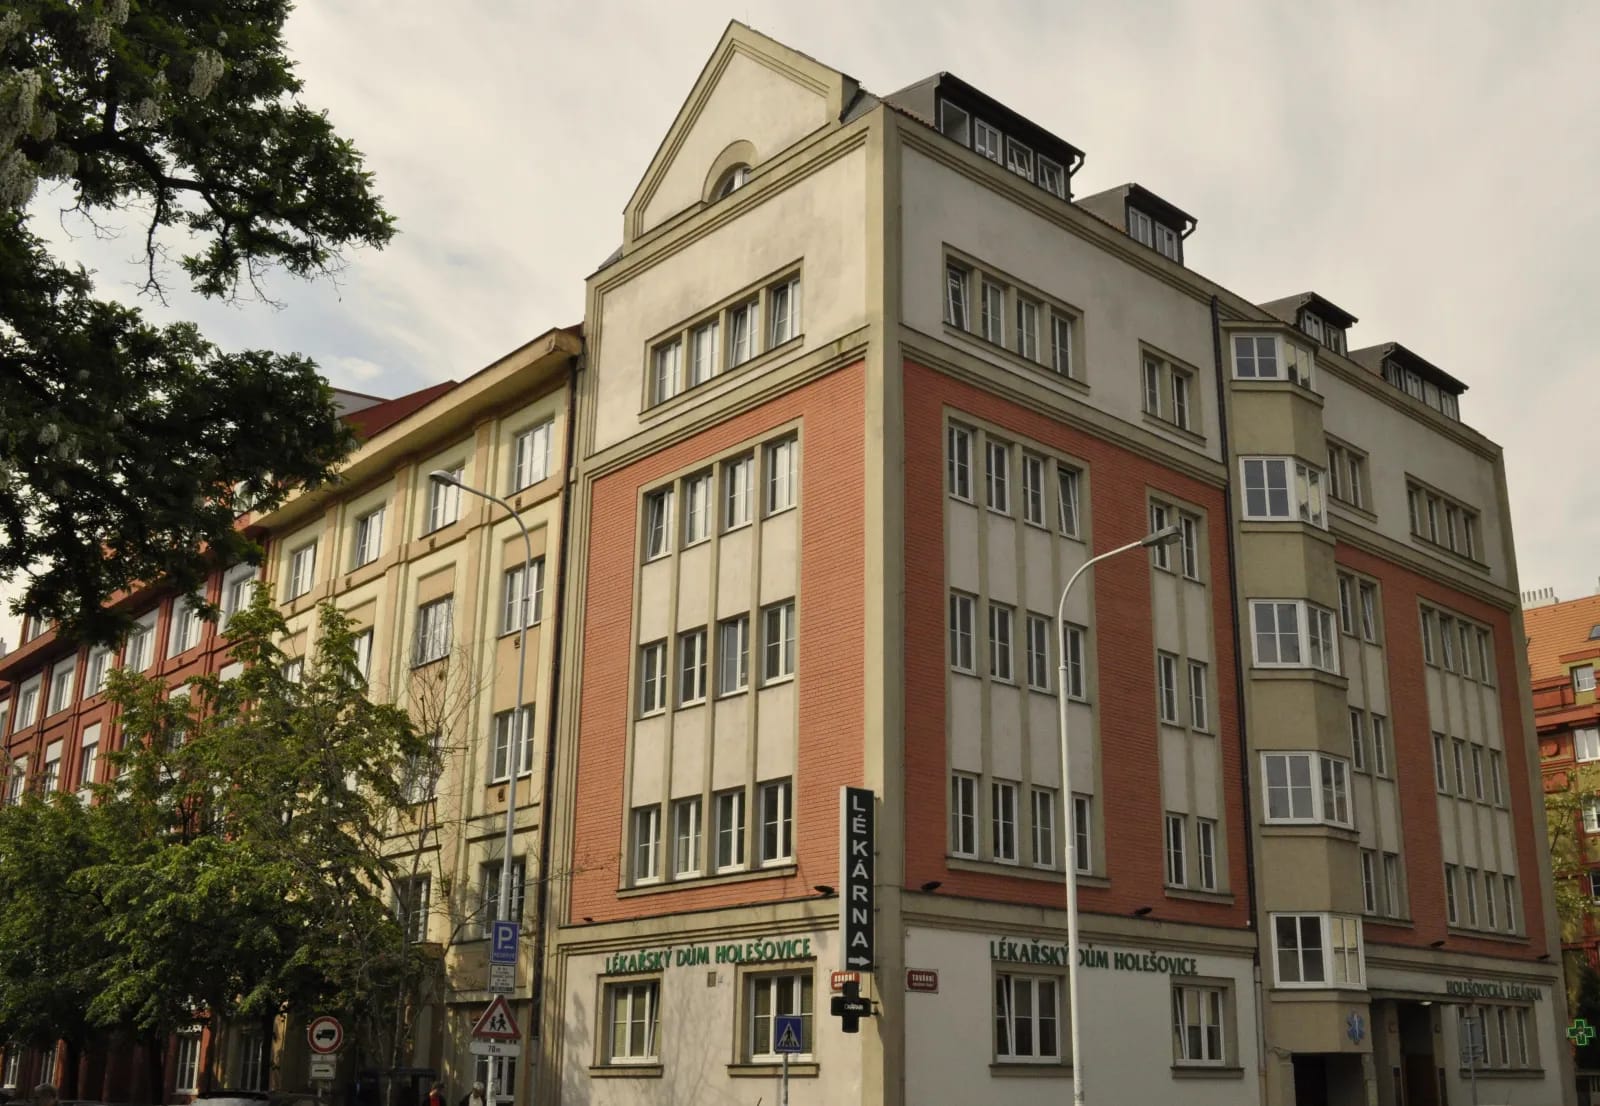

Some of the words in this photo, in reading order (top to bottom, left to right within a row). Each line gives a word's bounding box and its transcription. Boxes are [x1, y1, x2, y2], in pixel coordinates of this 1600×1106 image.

[851, 794, 869, 949] LÉKÁRNA
[497, 926, 514, 950] P
[605, 945, 672, 974] LÉKAŘSKÝ
[676, 943, 710, 967] DŮM
[715, 936, 812, 963] HOLEŠOVICE
[990, 936, 1069, 966] LÉKAŘSKÝ
[1114, 951, 1198, 976] HOLEŠOVICE
